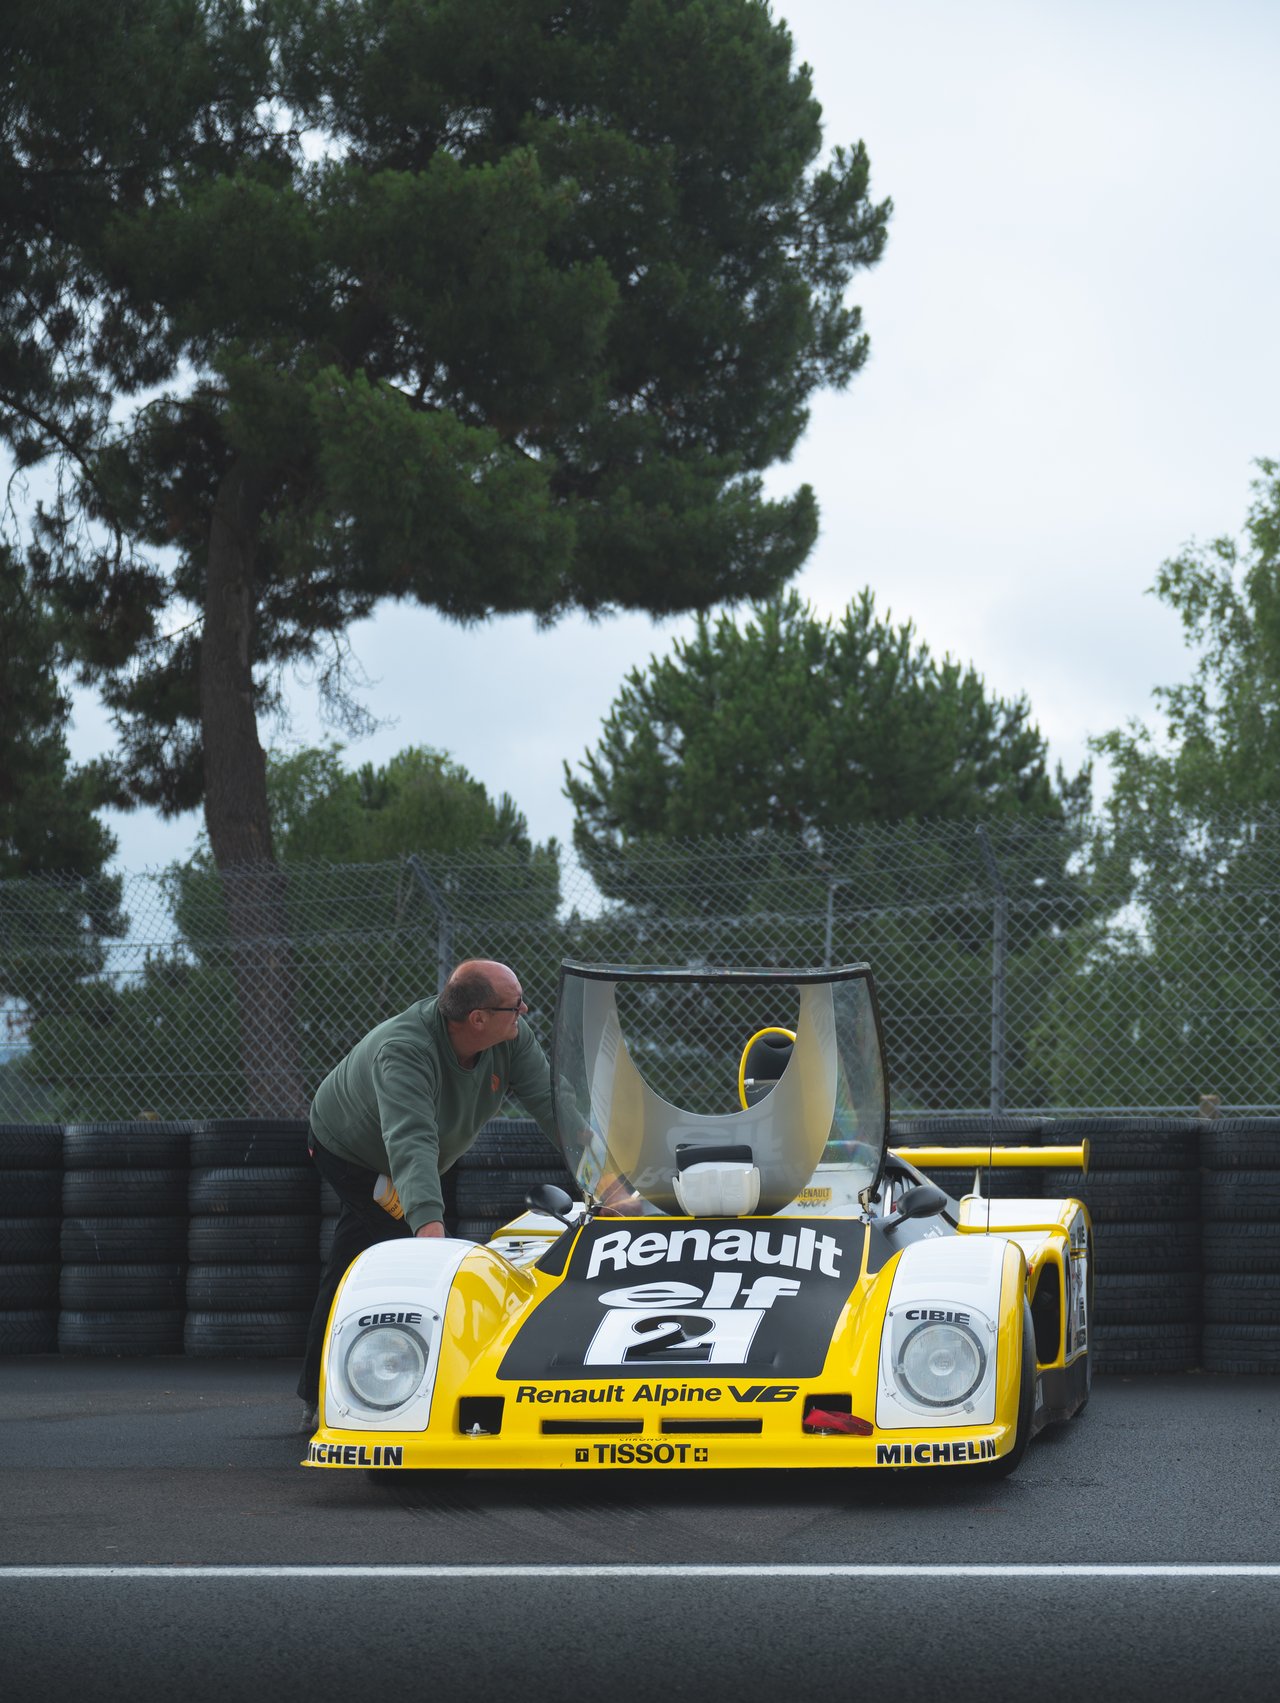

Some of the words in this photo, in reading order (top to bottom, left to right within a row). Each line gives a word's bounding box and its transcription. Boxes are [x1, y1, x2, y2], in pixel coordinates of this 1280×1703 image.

[586, 1227, 843, 1279] Renault
[598, 1272, 801, 1309] elf
[621, 1314, 716, 1364] 2
[515, 1384, 626, 1404] Renault
[632, 1384, 722, 1407] Alpine
[727, 1385, 800, 1403] V6
[593, 1443, 691, 1464] TISSOT
[876, 1438, 996, 1464] MICHELIN
